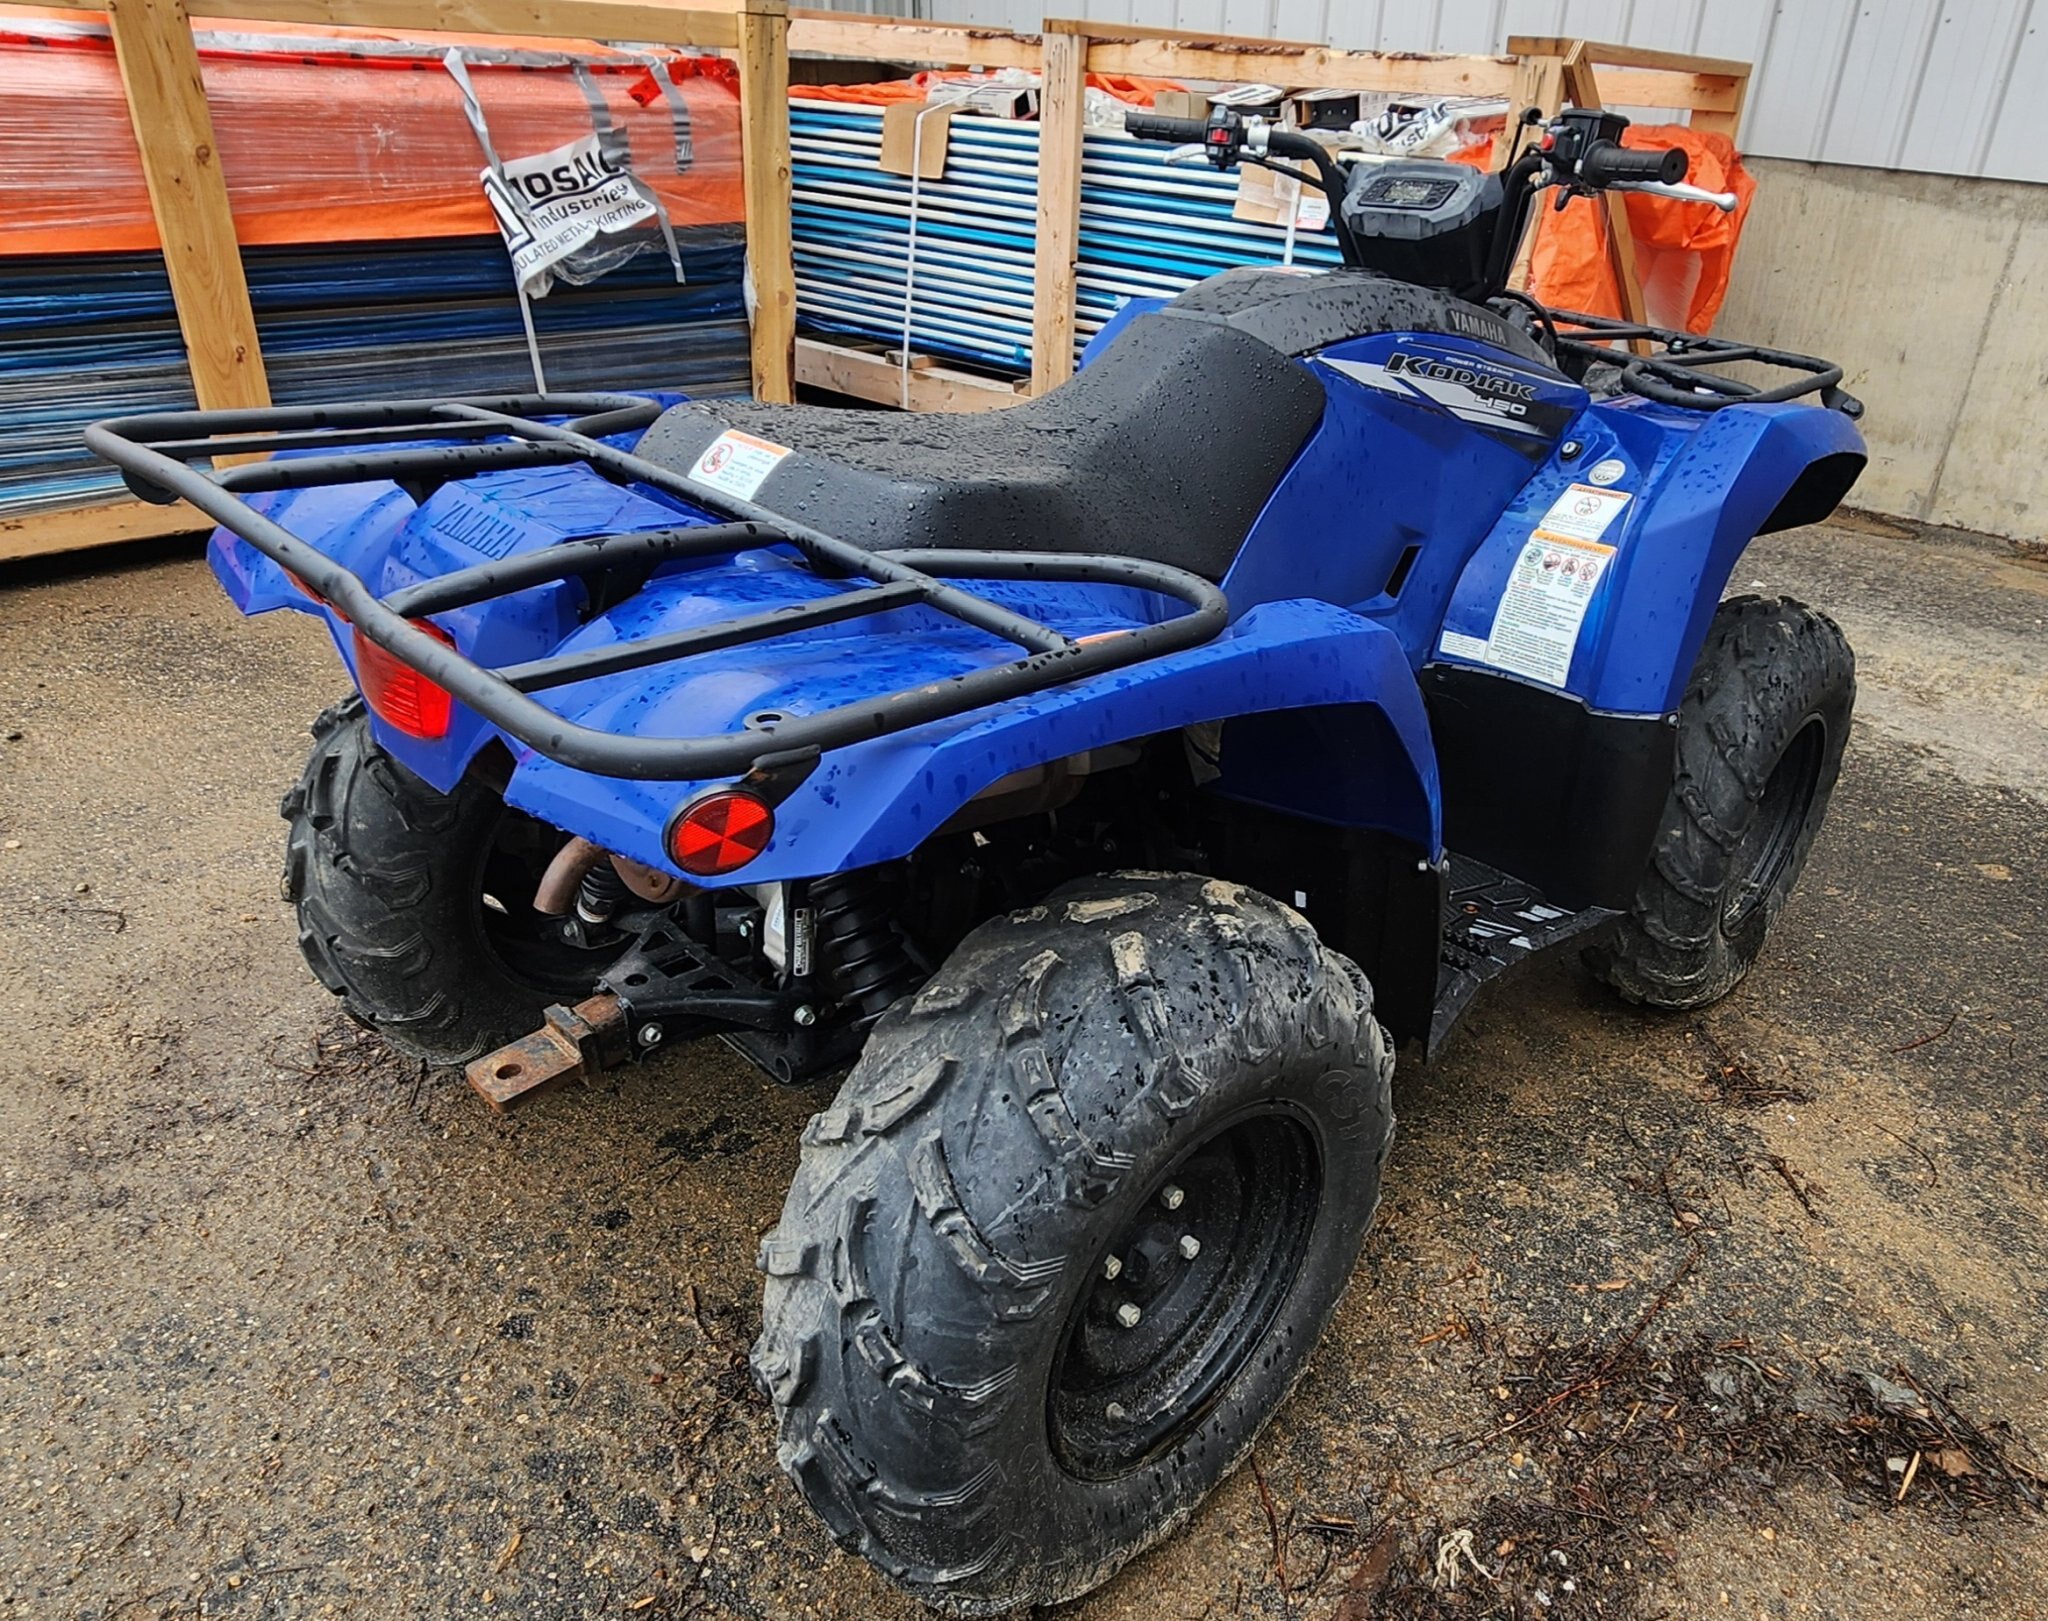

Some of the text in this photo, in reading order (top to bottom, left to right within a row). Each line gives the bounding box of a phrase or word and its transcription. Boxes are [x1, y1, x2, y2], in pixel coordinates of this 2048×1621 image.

[1451, 310, 1507, 344] YAMAHA
[1384, 352, 1537, 402] KODIAK
[1475, 394, 1528, 416] 450
[431, 499, 526, 562] YAMAHA
